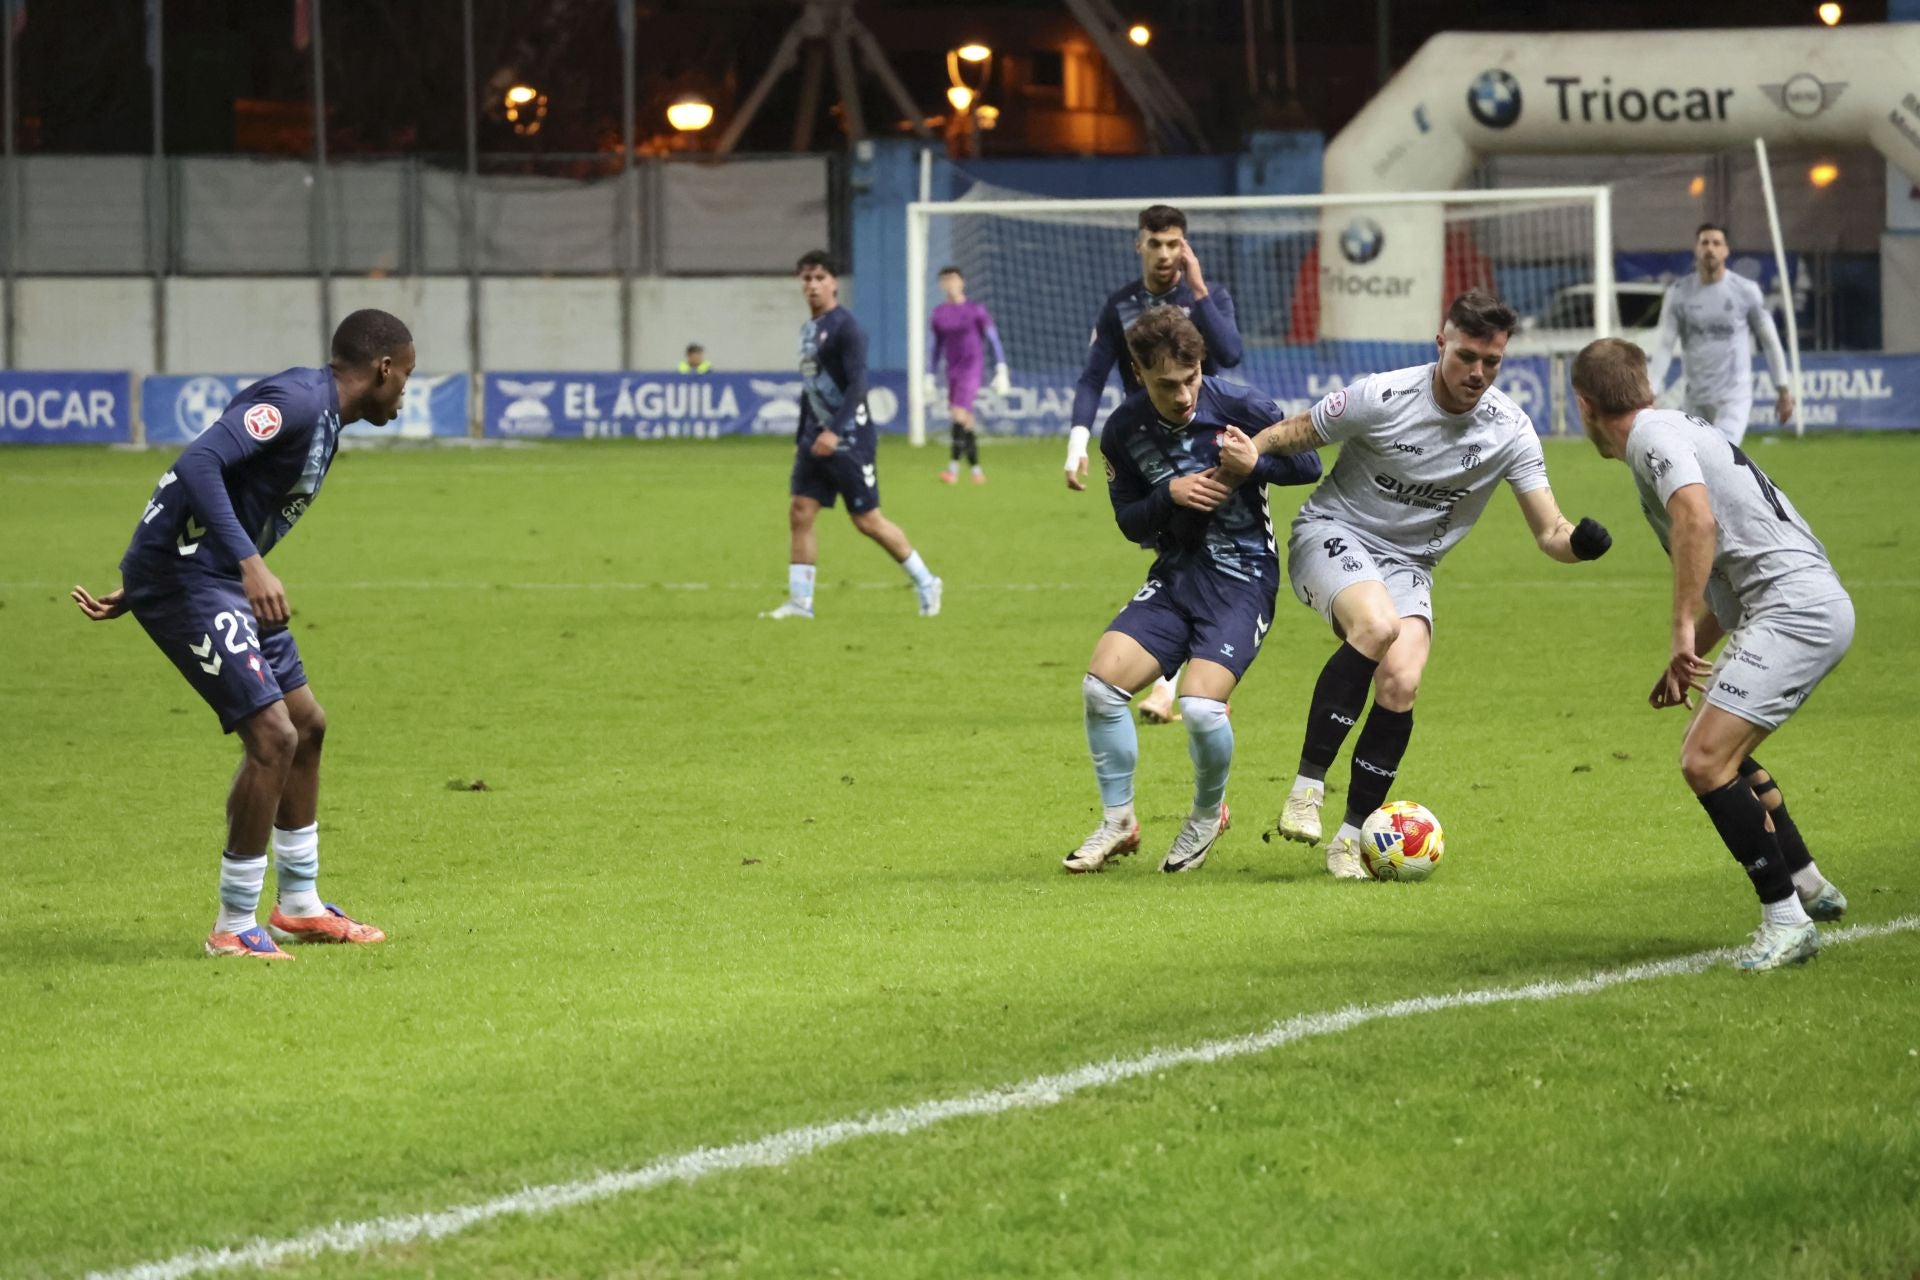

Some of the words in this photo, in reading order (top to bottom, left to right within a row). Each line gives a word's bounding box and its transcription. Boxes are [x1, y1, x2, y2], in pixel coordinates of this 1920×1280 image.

[1546, 76, 1735, 122] Triocar
[564, 382, 602, 419] EL
[612, 377, 741, 420] ÁGUILA
